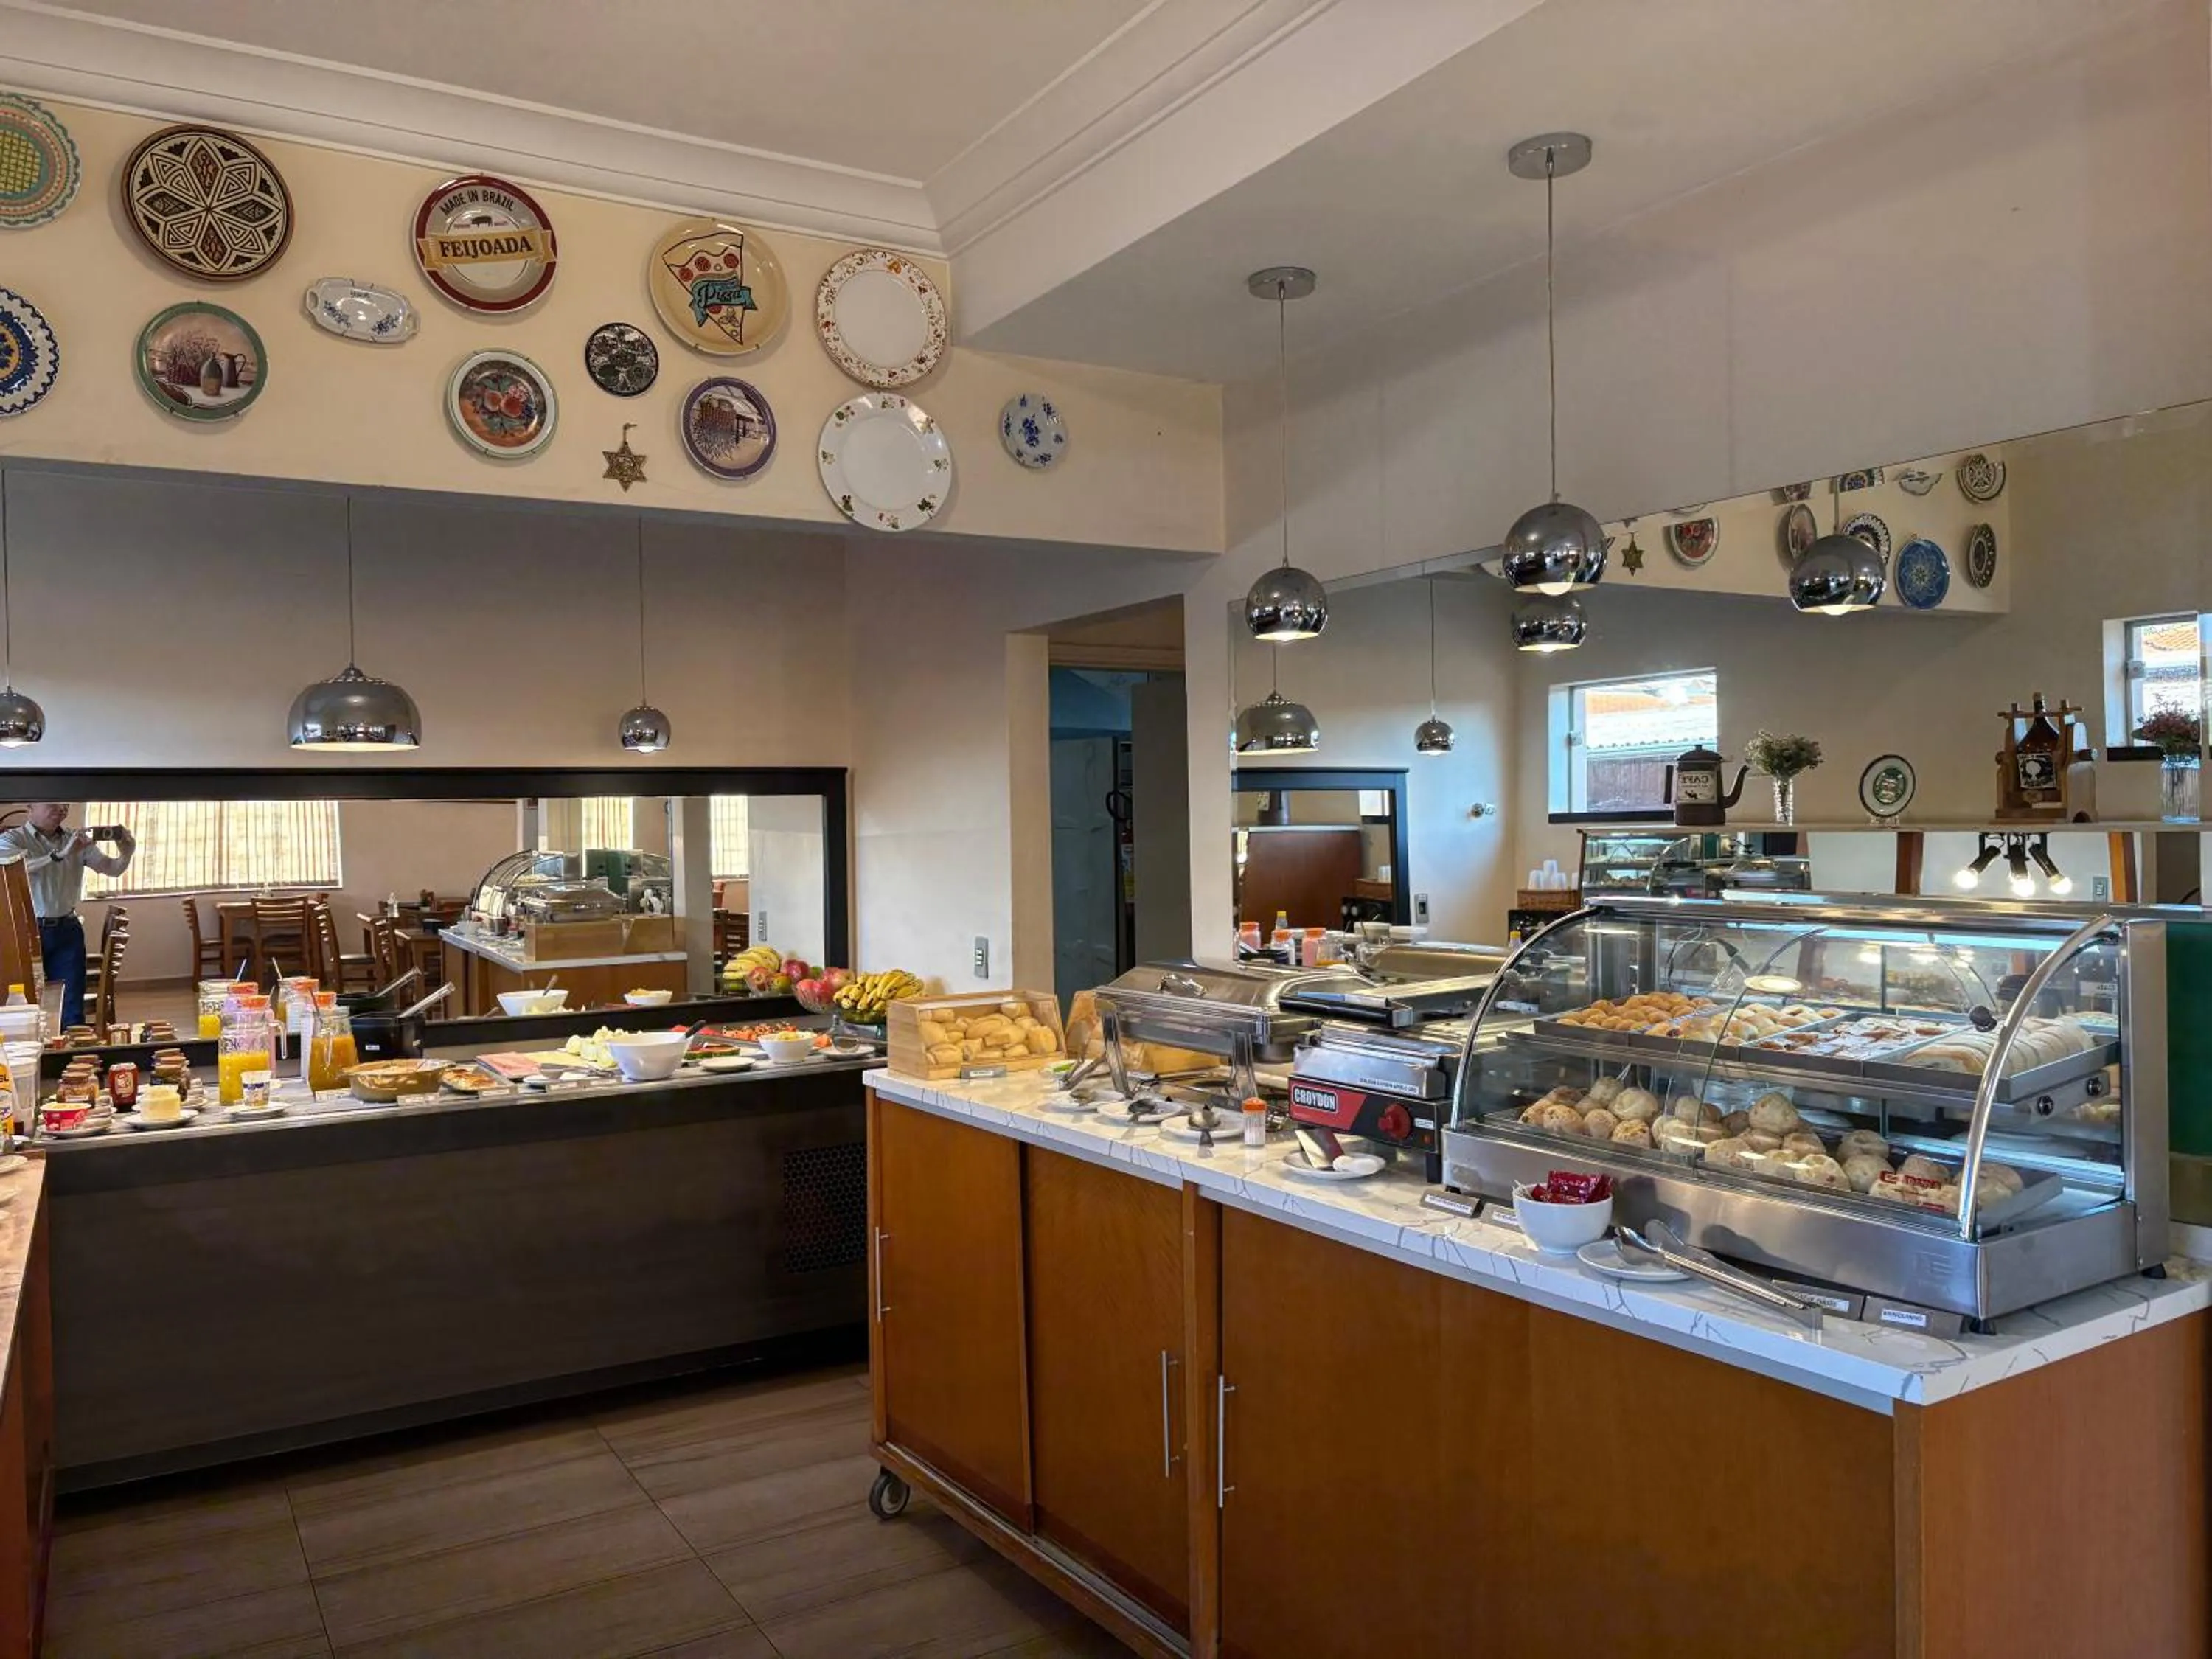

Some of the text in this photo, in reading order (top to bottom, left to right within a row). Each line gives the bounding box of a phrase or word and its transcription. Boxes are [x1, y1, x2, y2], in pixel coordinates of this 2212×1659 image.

[440, 190, 514, 215] MADE IN BRAZIL
[439, 237, 532, 258] FEIJOADA
[1294, 1088, 1335, 1110] CROYDON
